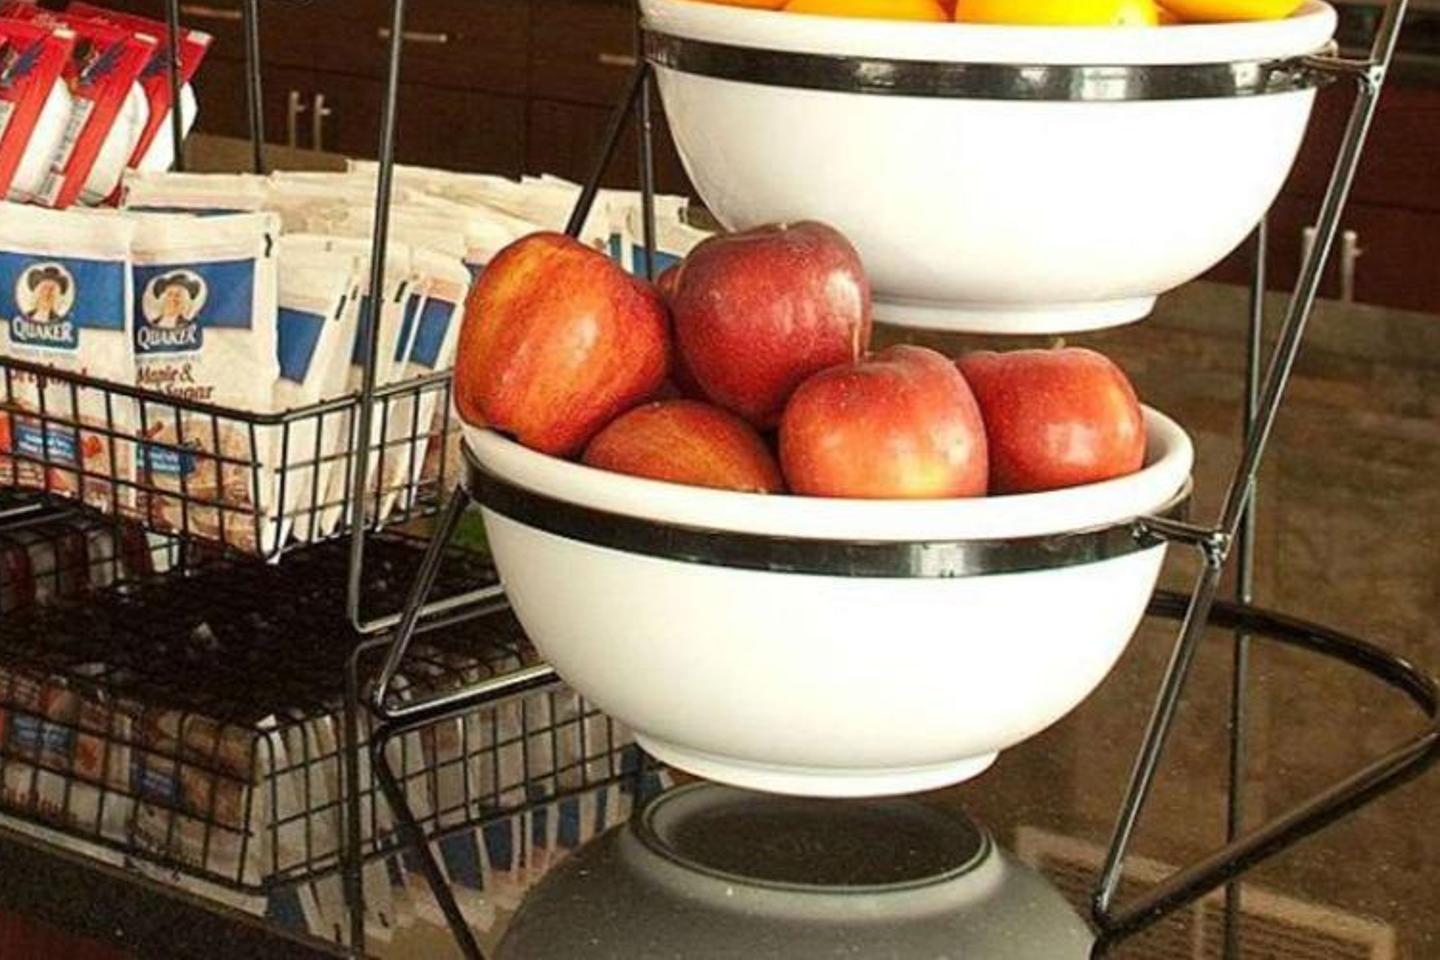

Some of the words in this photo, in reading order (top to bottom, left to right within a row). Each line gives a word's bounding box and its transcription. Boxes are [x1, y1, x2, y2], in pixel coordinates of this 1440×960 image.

[12, 316, 74, 342] QUAKER
[137, 324, 198, 351] QUAKER
[179, 361, 196, 384] &
